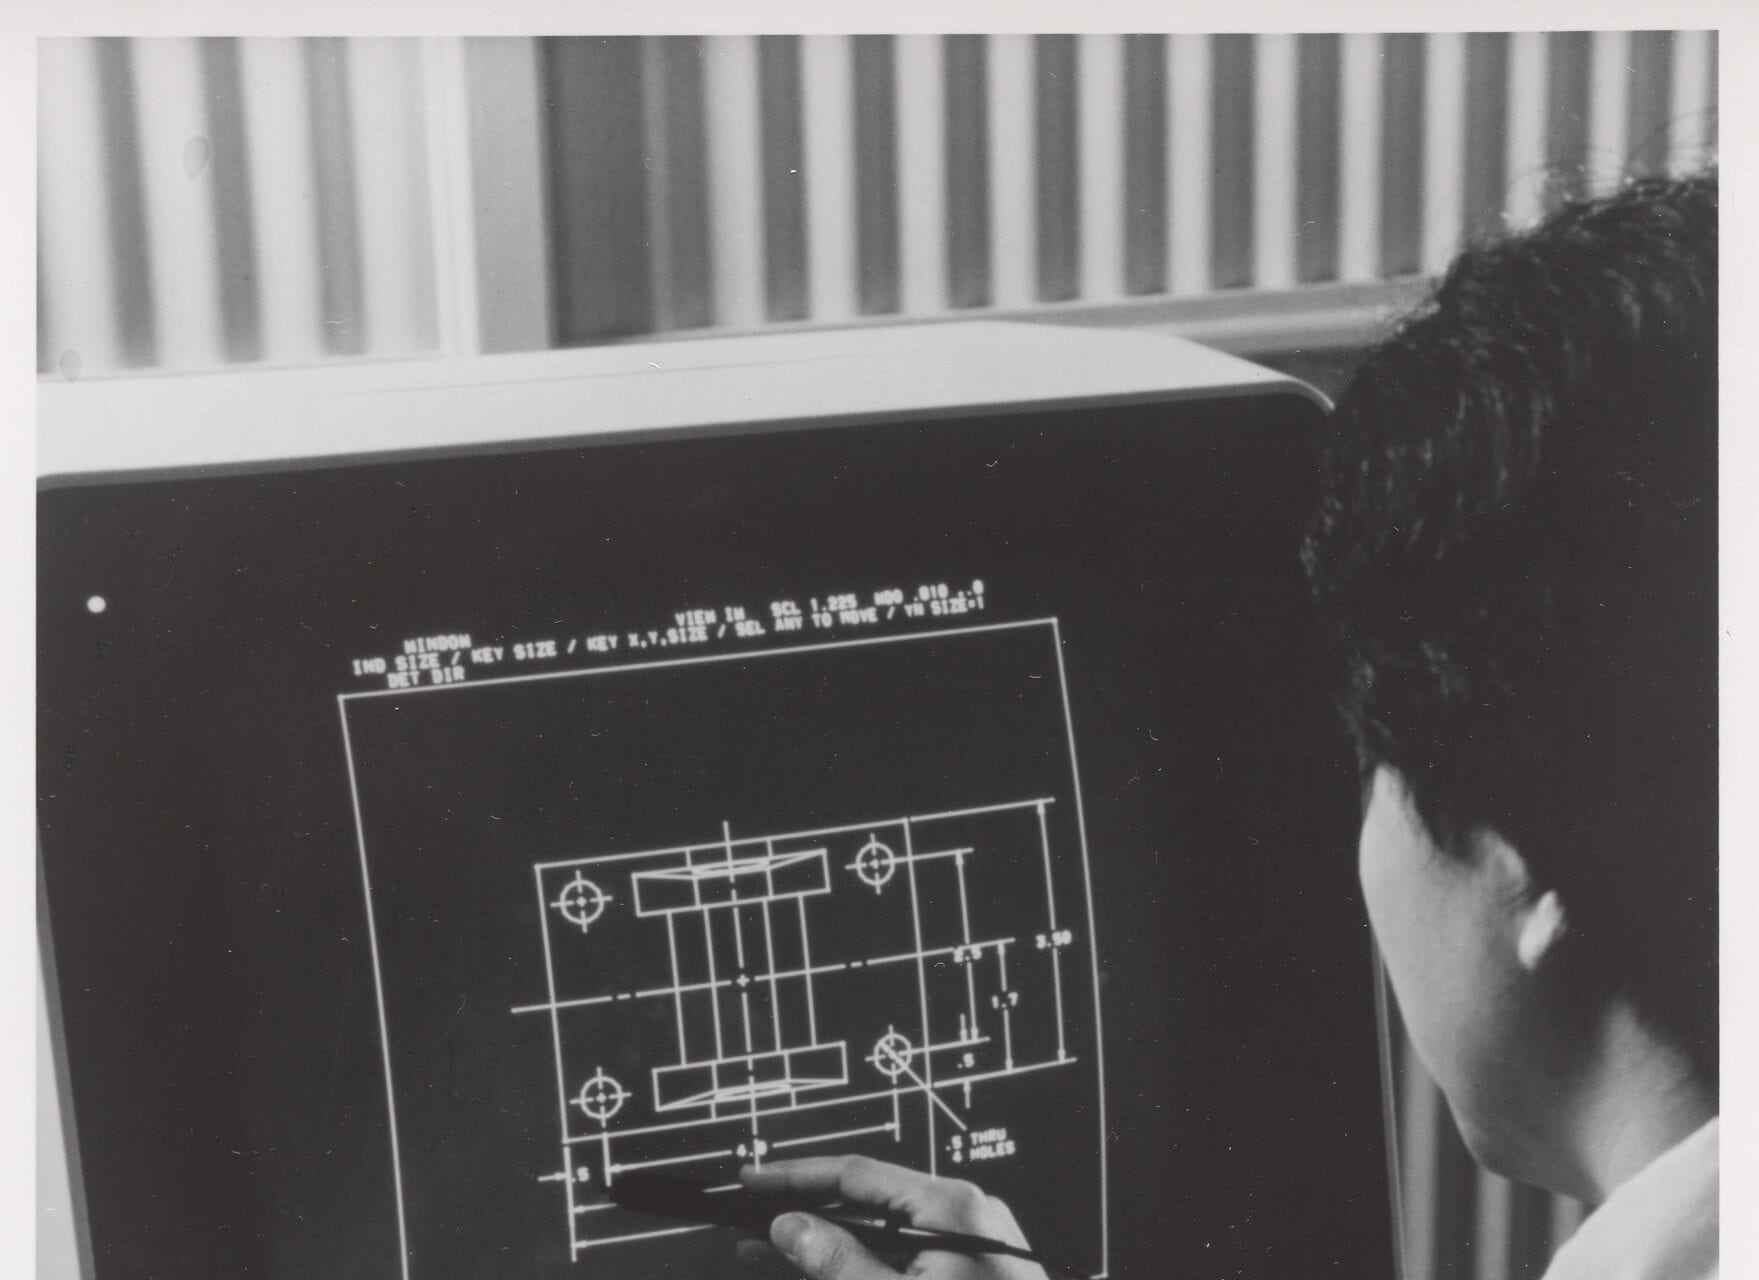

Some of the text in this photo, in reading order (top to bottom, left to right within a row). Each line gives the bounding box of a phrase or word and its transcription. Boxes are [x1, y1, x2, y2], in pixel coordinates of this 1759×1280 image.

[404, 633, 471, 654] WINDOW
[675, 610, 716, 627] VIEW
[725, 606, 745, 622] IN
[771, 600, 801, 617] SCL
[810, 594, 857, 612] 1.225
[395, 652, 440, 671] SIZE
[471, 647, 503, 664] KEY
[513, 640, 557, 660] SIZE
[587, 635, 618, 652] KEY
[735, 620, 766, 637] SEL
[775, 616, 803, 631] ANY
[811, 612, 832, 628] TO
[839, 607, 878, 625] MOVE
[387, 665, 465, 689] DET DIR
[991, 992, 1018, 1009] 1.7
[957, 1052, 975, 1069] .5
[970, 1127, 1006, 1146] THRU
[970, 1140, 1015, 1160] HOLES
